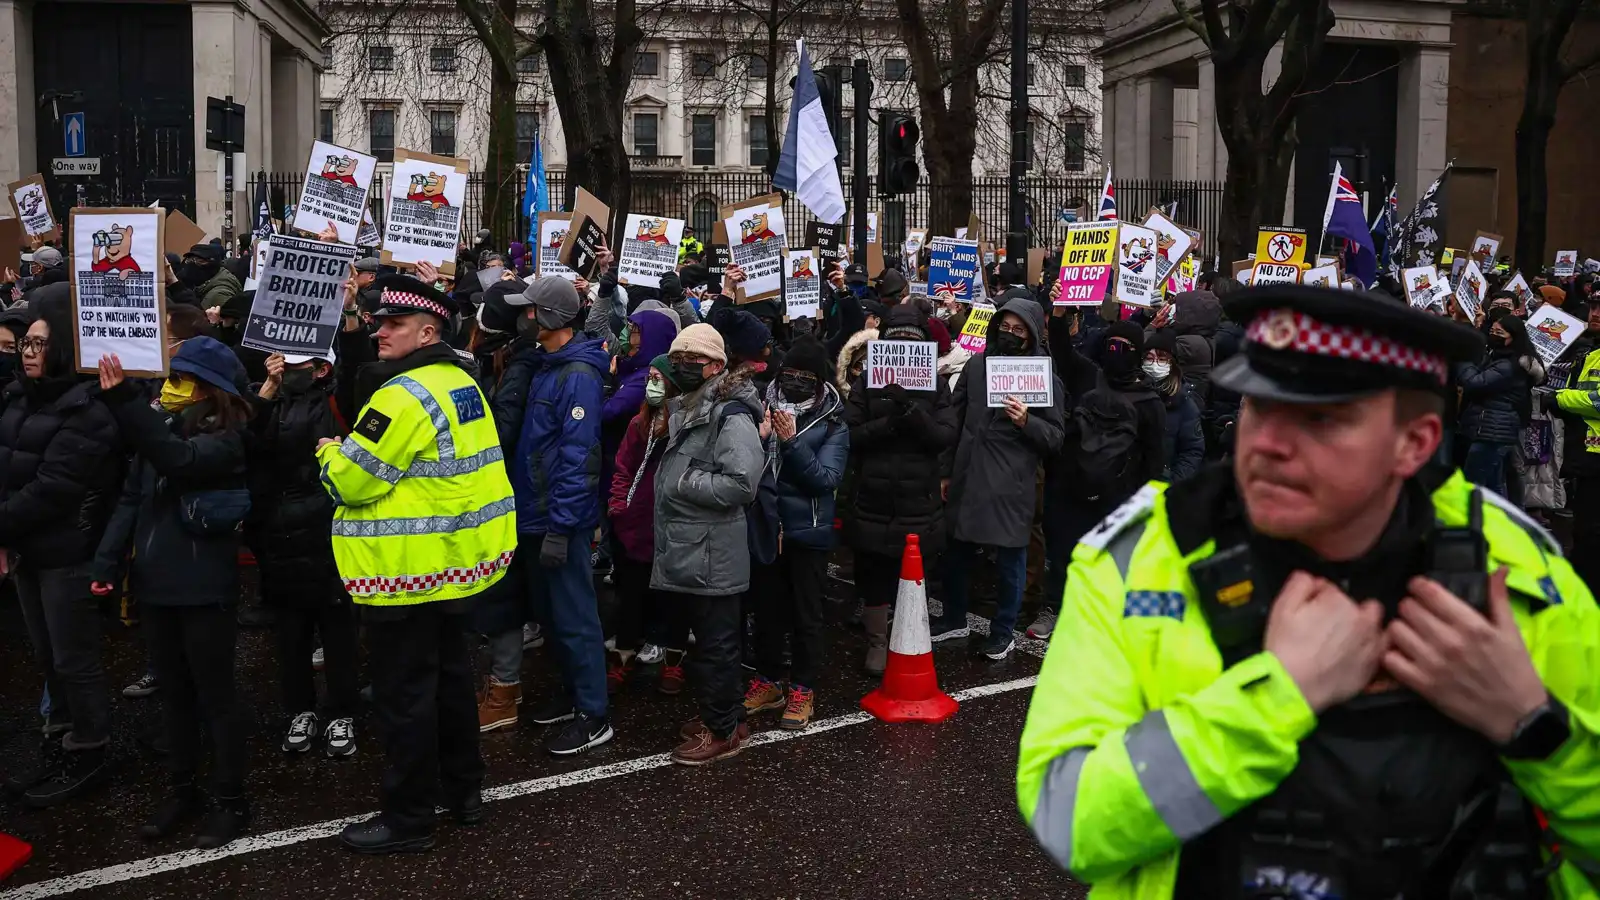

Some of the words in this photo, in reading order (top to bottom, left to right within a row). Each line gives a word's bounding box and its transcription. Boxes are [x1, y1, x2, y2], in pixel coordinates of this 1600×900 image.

[56, 161, 74, 170] One
[79, 163, 98, 172] way
[303, 196, 314, 204] CCP
[322, 202, 349, 214] WATCHING
[350, 210, 361, 218] YOU
[300, 204, 312, 212] STOP
[313, 208, 321, 216] THE
[322, 211, 336, 220] MEGA
[336, 214, 358, 226] EMBASSY
[413, 228, 442, 238] WATCHING
[588, 224, 600, 238] SPACE
[816, 227, 834, 236] SPACE
[1072, 230, 1110, 245] HANDS
[270, 236, 284, 245] SAVE
[298, 242, 310, 250] BAN
[311, 244, 332, 252] CHINA'S
[332, 246, 356, 256] EMBASSY
[388, 234, 401, 242] STOP
[413, 238, 428, 246] MEGA
[430, 240, 455, 250] EMBASSY
[932, 244, 956, 252] BRITS'
[930, 258, 954, 268] BRITS'
[952, 252, 976, 262] LANDS
[1069, 250, 1088, 264] OFF
[1092, 249, 1108, 262] UK
[270, 250, 348, 277] PROTECT
[640, 261, 664, 270] WATCHING
[754, 259, 778, 270] WATCHING
[949, 268, 974, 278] HANDS
[1064, 267, 1079, 280] NO
[1082, 266, 1105, 280] CCP
[1259, 265, 1273, 275] NO
[1276, 266, 1294, 277] CCP
[268, 275, 338, 300] BRITAIN
[1068, 285, 1094, 298] STAY
[81, 311, 94, 321] CCP
[96, 312, 103, 322] IS
[105, 312, 140, 323] WATCHING
[143, 313, 157, 323] YOU
[272, 300, 322, 322] FROM
[82, 326, 96, 337] STOP
[97, 327, 107, 337] THE
[109, 327, 126, 338] MEGA
[128, 327, 157, 338] EMBASSY
[264, 321, 318, 344] CHINA
[967, 322, 980, 333] OFF
[960, 334, 970, 344] NO
[971, 336, 986, 348] CCP
[872, 344, 905, 355] STAND
[908, 345, 932, 356] TALL
[872, 355, 905, 366] STAND
[908, 356, 932, 368] FREE
[872, 367, 895, 385] NO
[896, 368, 932, 378] CHINESE
[896, 378, 932, 387] EMBASSY!
[992, 375, 1014, 390] STOP
[1018, 375, 1045, 390] CHINA
